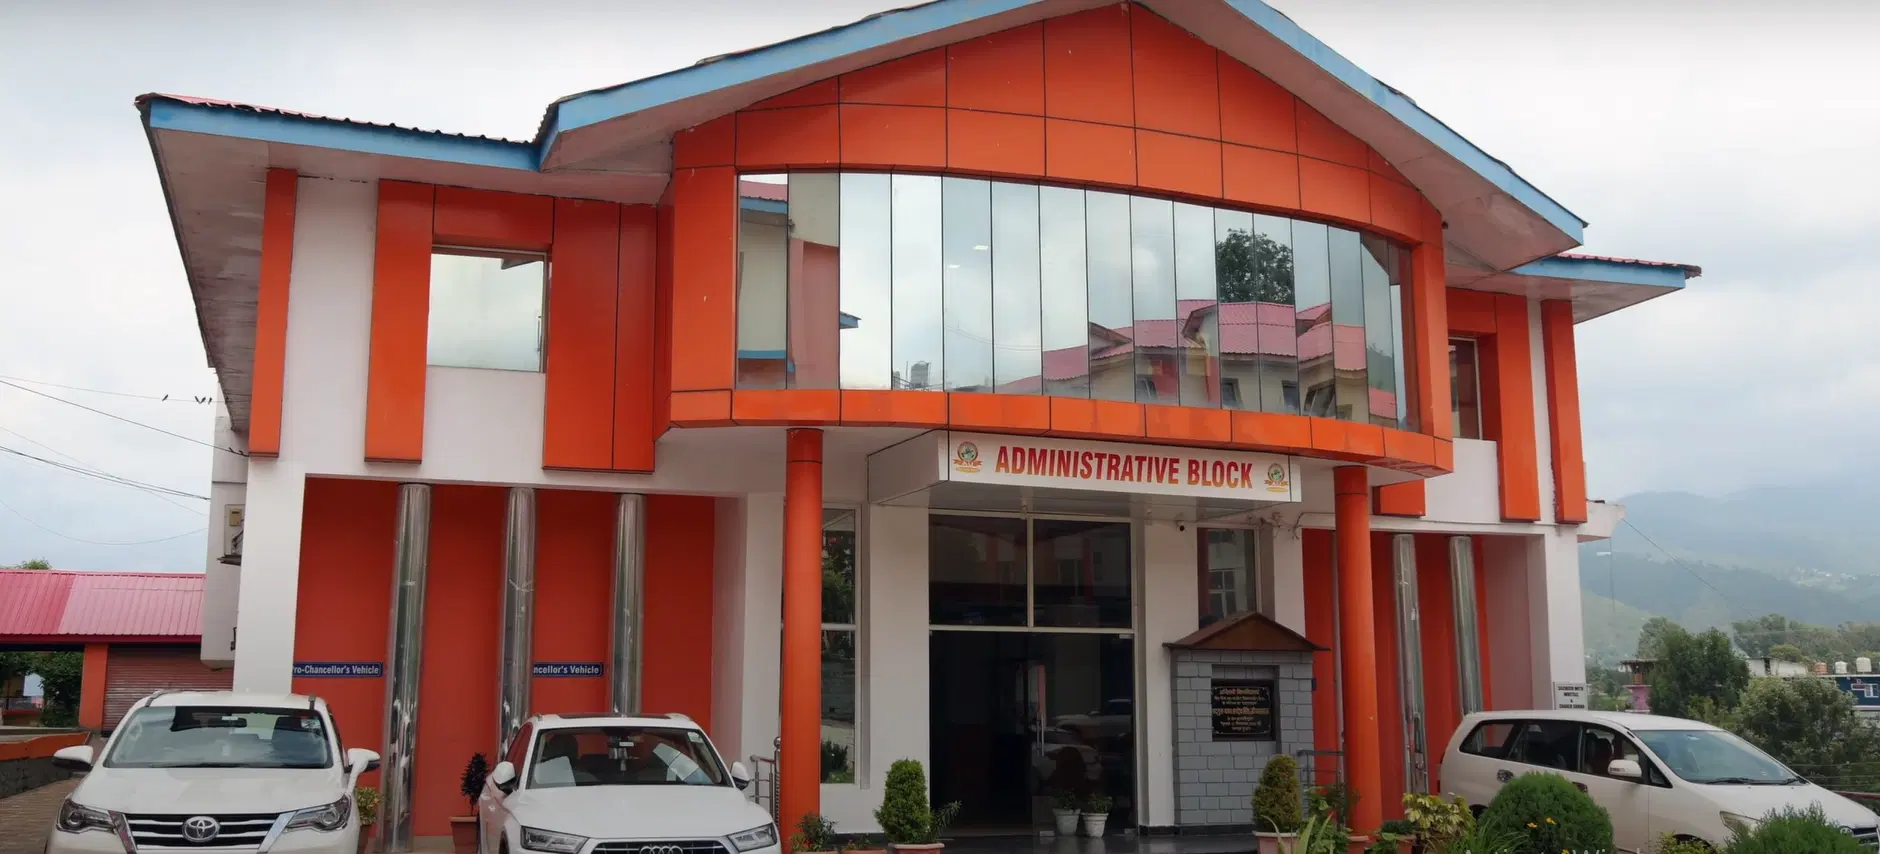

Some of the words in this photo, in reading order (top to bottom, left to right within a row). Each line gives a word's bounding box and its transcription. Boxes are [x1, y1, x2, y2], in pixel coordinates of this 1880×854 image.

[995, 445, 1180, 485] ADMINISTRATIVE
[1187, 459, 1253, 489] BLOCK
[292, 664, 350, 675] ro-Chancellor's
[351, 665, 379, 675] Vehicle
[569, 665, 599, 674] Vehicle
